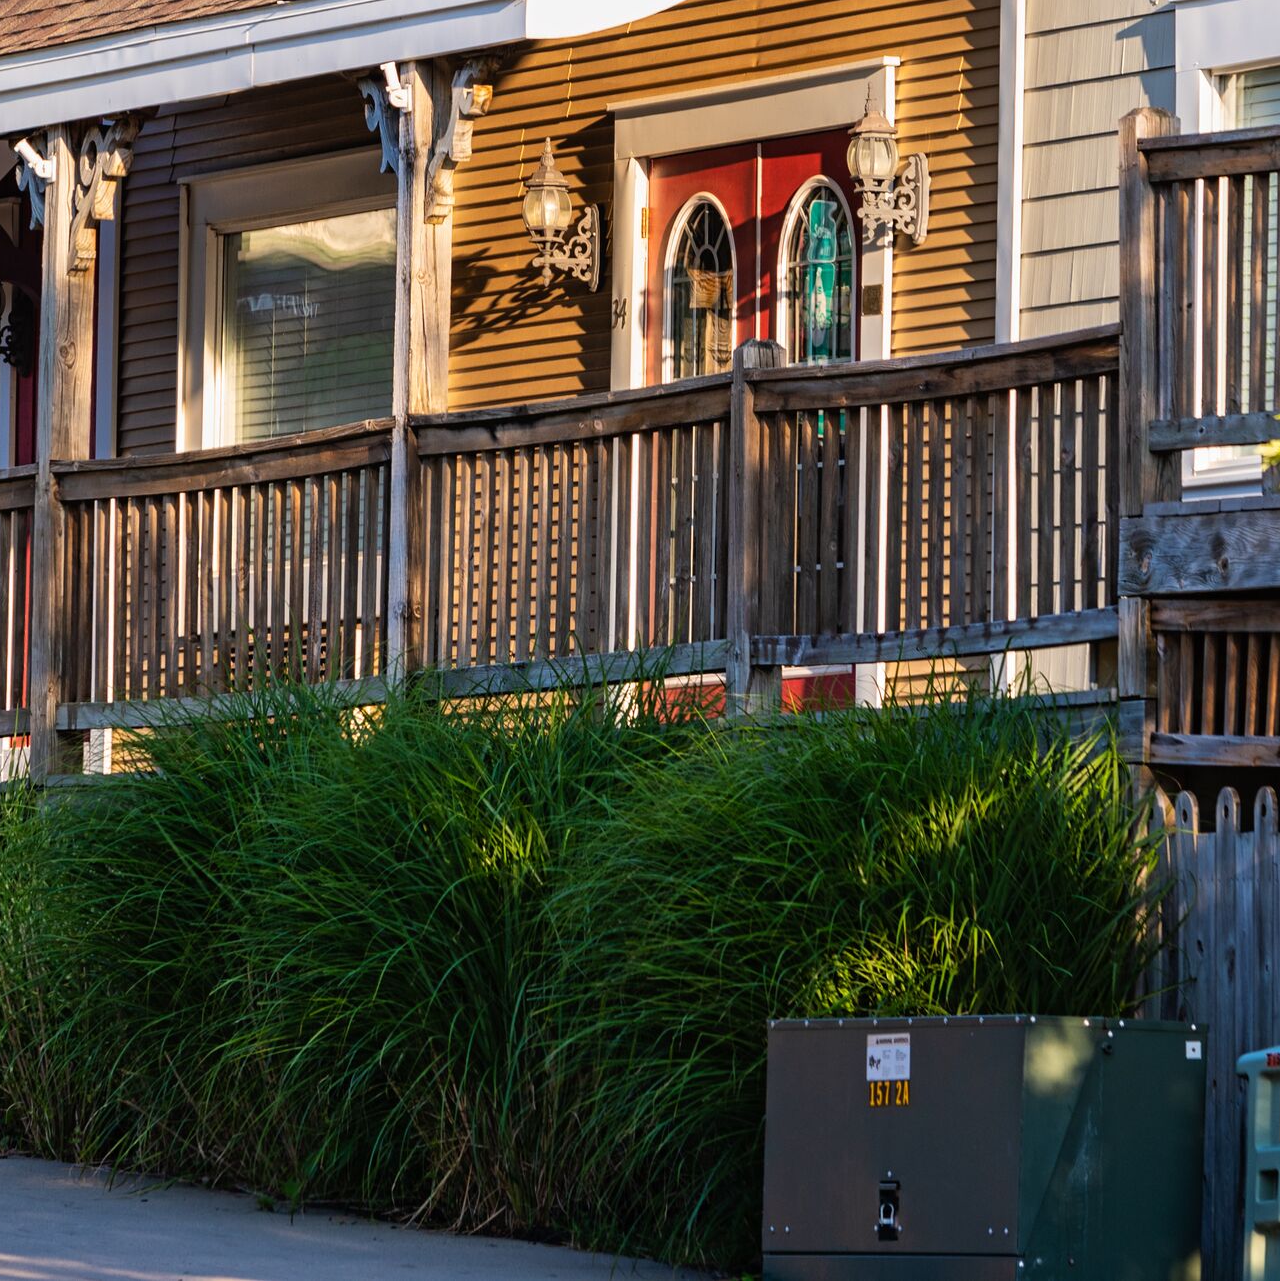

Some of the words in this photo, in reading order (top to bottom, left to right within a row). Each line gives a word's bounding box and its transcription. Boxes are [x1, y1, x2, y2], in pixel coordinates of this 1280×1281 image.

[612, 298, 627, 330] 34
[870, 1080, 890, 1106] 157
[896, 1080, 910, 1106] 2A
